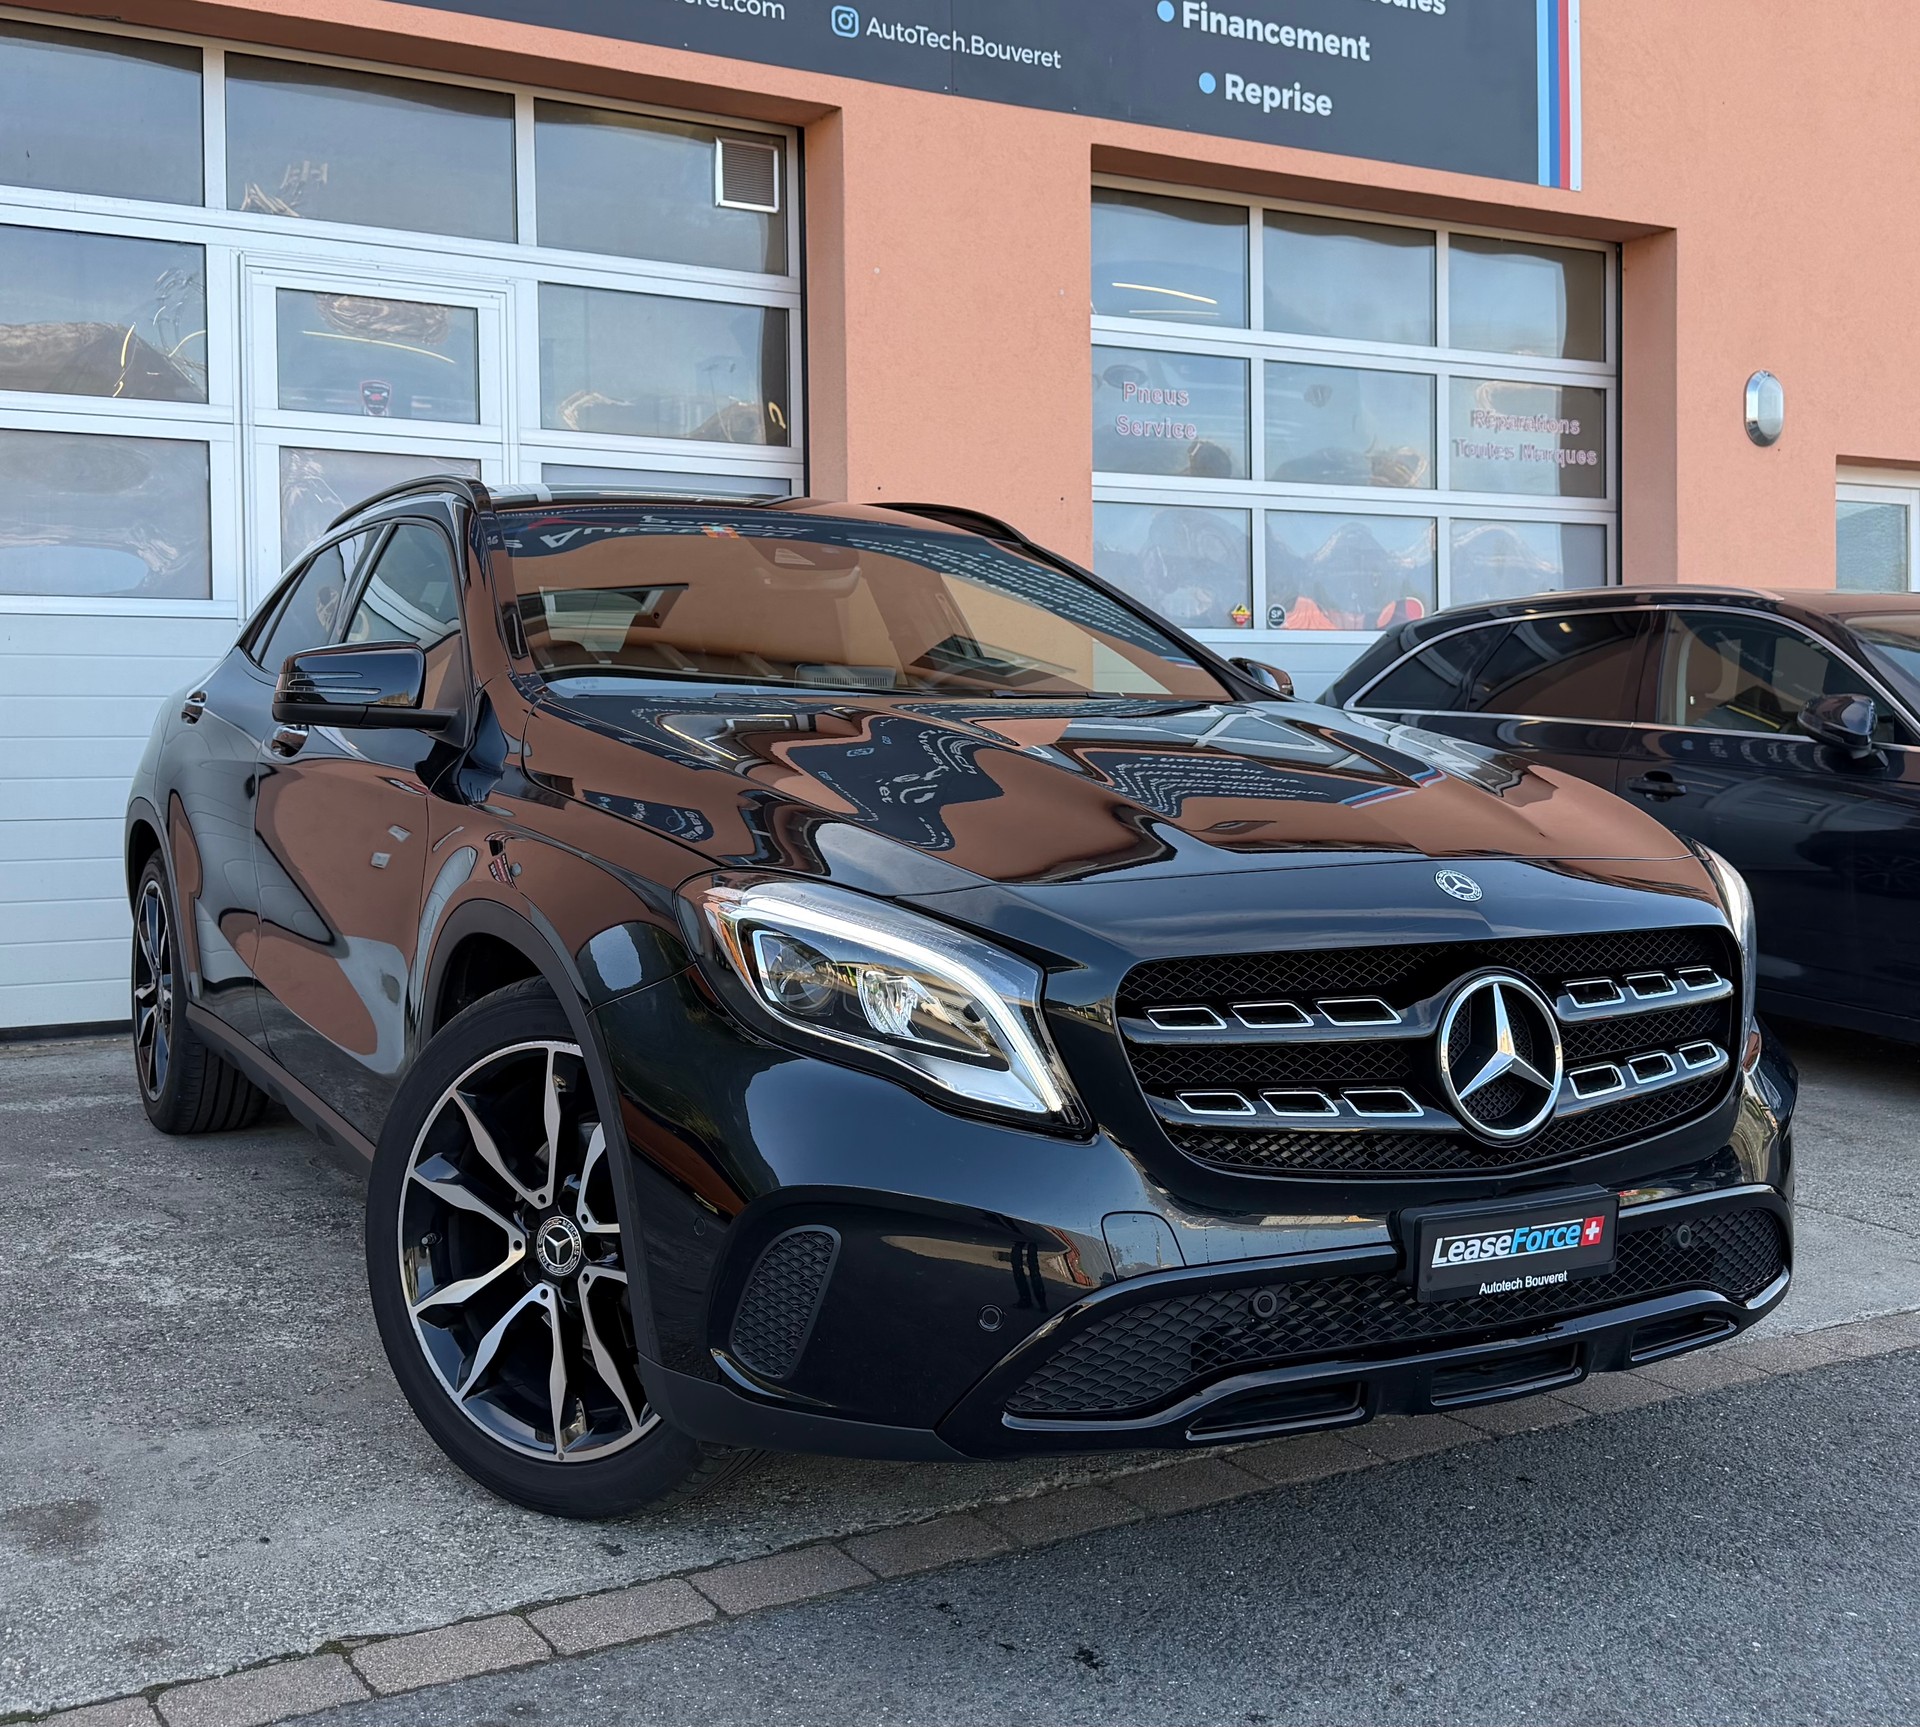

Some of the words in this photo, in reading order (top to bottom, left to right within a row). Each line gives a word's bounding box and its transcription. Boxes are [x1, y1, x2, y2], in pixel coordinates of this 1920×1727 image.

[866, 17, 1062, 69] AutoTech.Bouveret
[1183, 0, 1371, 61] Financement
[1225, 73, 1333, 116] Reprise
[1123, 381, 1190, 406] Pneus
[1116, 414, 1197, 439] Service
[1433, 1224, 1581, 1264] LeaseForce
[1479, 1277, 1523, 1295] Autotech
[1525, 1271, 1568, 1289] Bouveret
